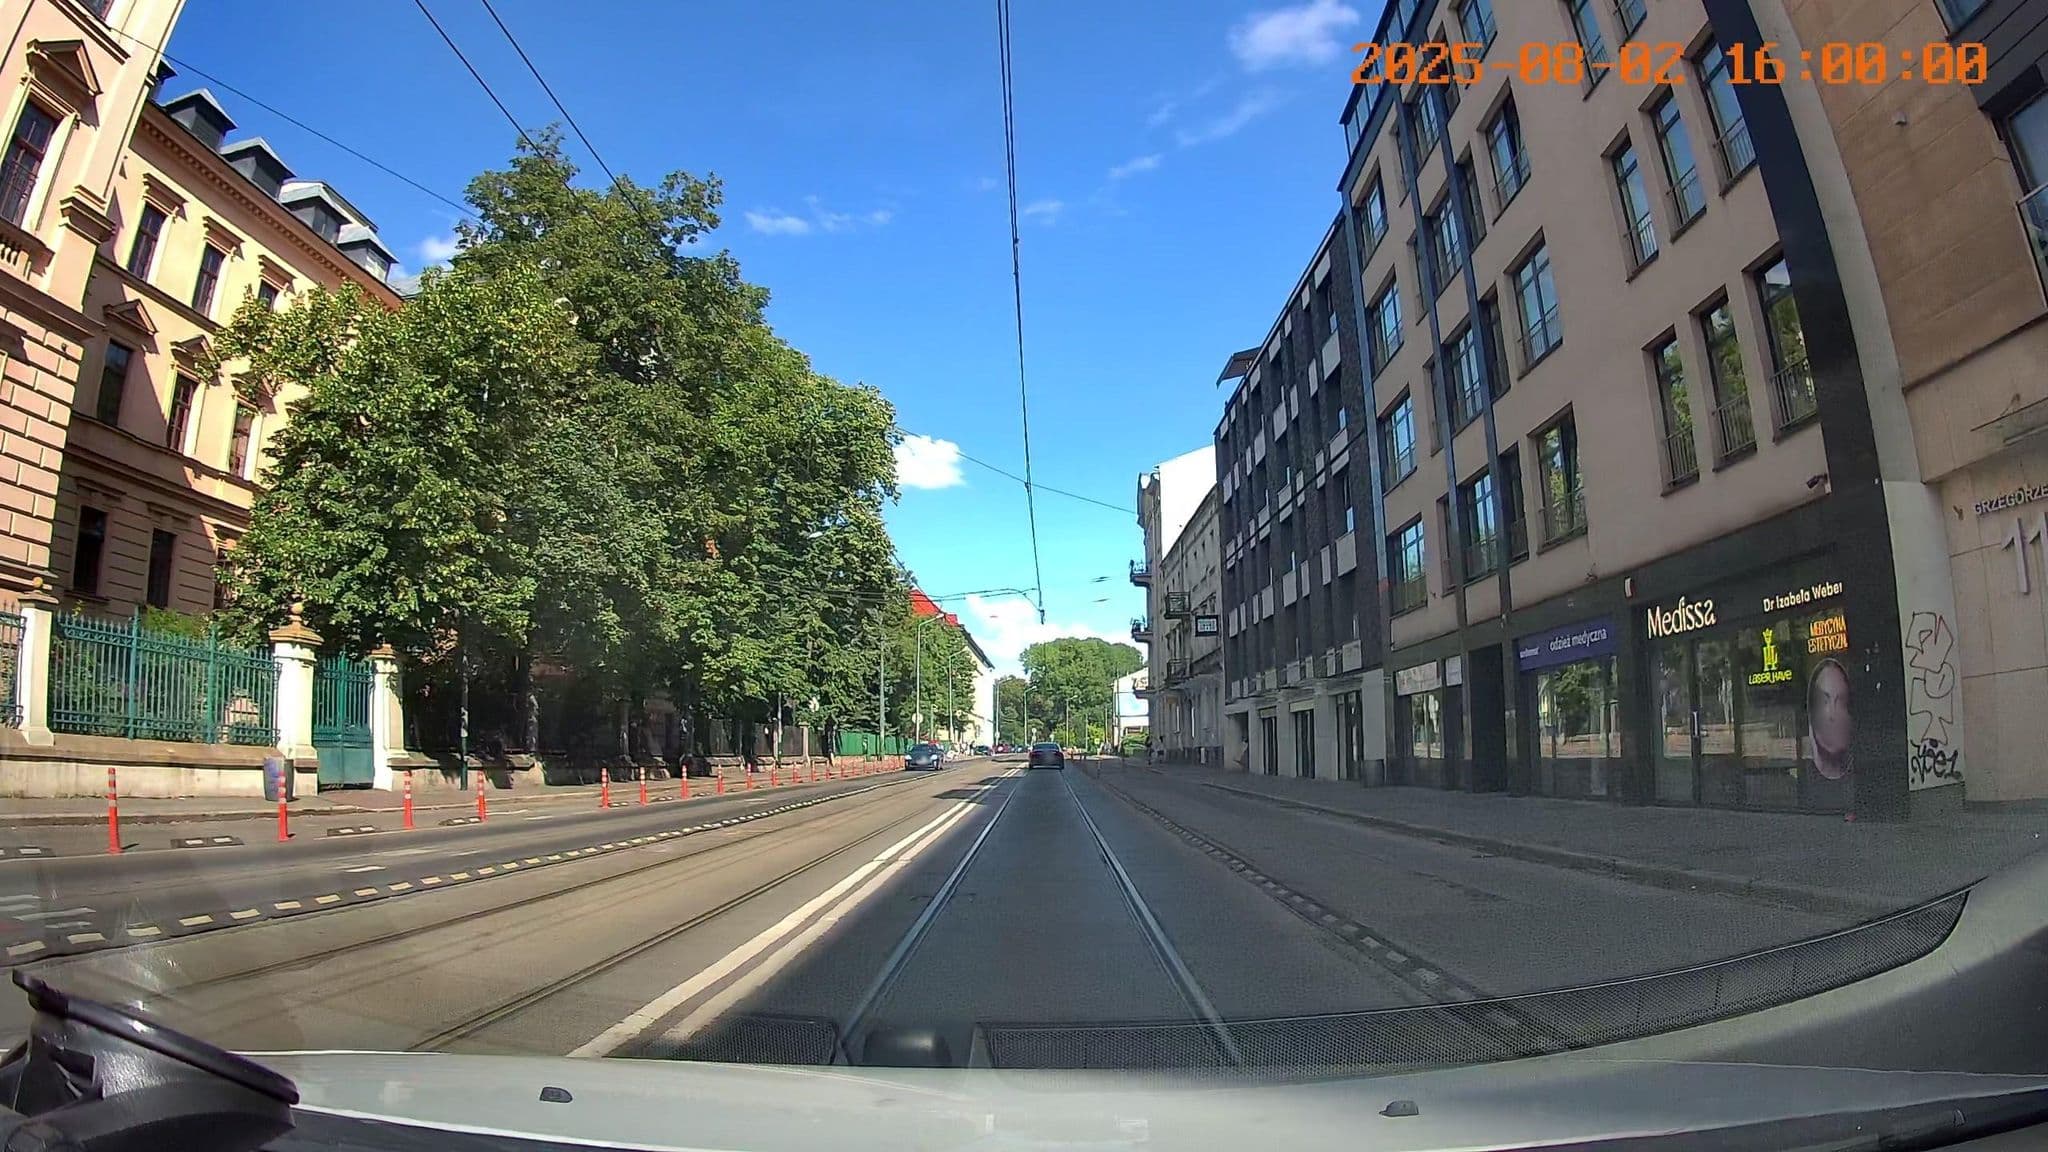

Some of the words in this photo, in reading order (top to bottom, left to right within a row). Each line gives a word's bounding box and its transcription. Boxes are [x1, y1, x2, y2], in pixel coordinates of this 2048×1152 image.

[1763, 598, 1775, 612] Dr
[1776, 589, 1810, 609] Izabela
[1647, 596, 1716, 639] Medissa
[1572, 629, 1607, 646] medyczna
